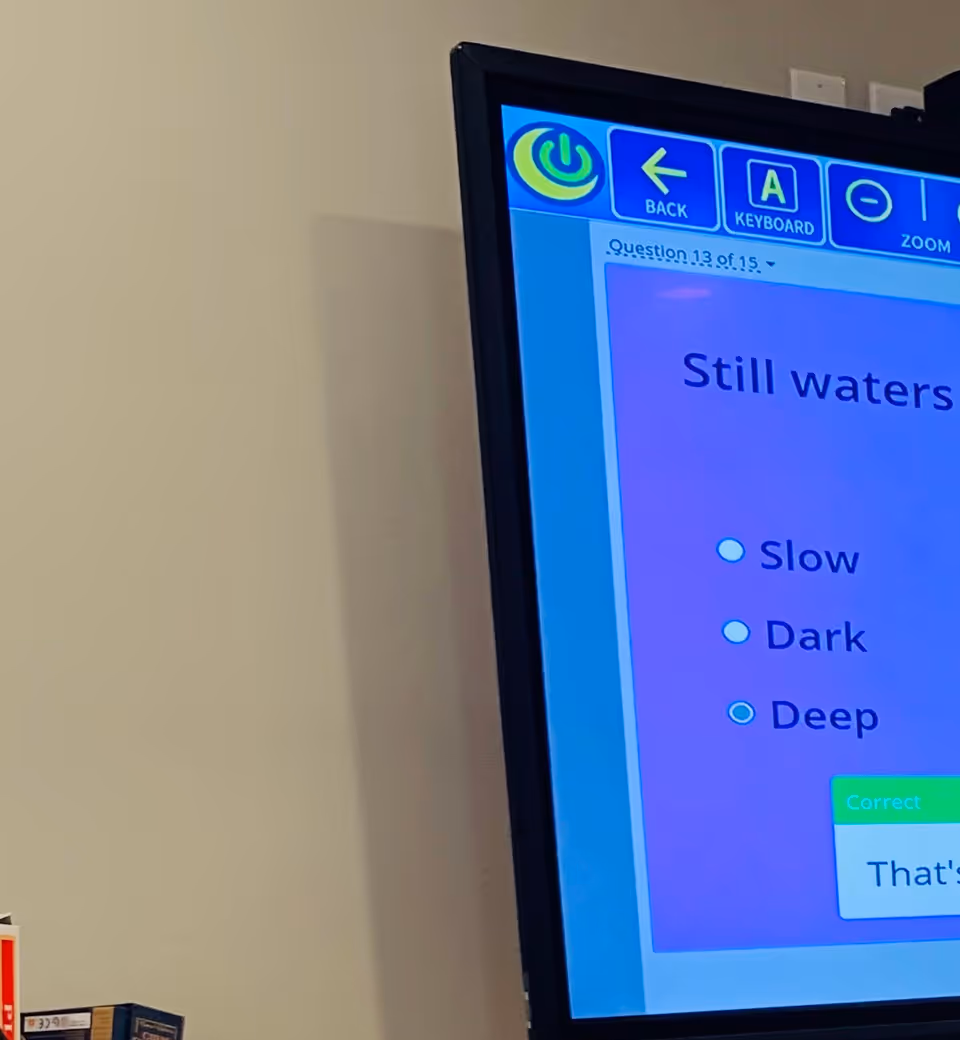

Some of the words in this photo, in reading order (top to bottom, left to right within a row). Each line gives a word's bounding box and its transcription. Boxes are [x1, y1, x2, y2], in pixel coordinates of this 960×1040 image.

[645, 199, 688, 219] BACK
[735, 212, 814, 236] KEYBOARD
[608, 238, 687, 260] Question
[693, 250, 712, 264] 13
[717, 252, 734, 267] of
[740, 256, 758, 270] 15
[901, 234, 951, 254] ZOOM
[683, 353, 774, 394] Still
[791, 368, 954, 412] waters
[761, 539, 860, 574] Slow
[767, 620, 868, 653] Dark
[771, 701, 879, 738] Deep
[847, 794, 921, 810] Correct
